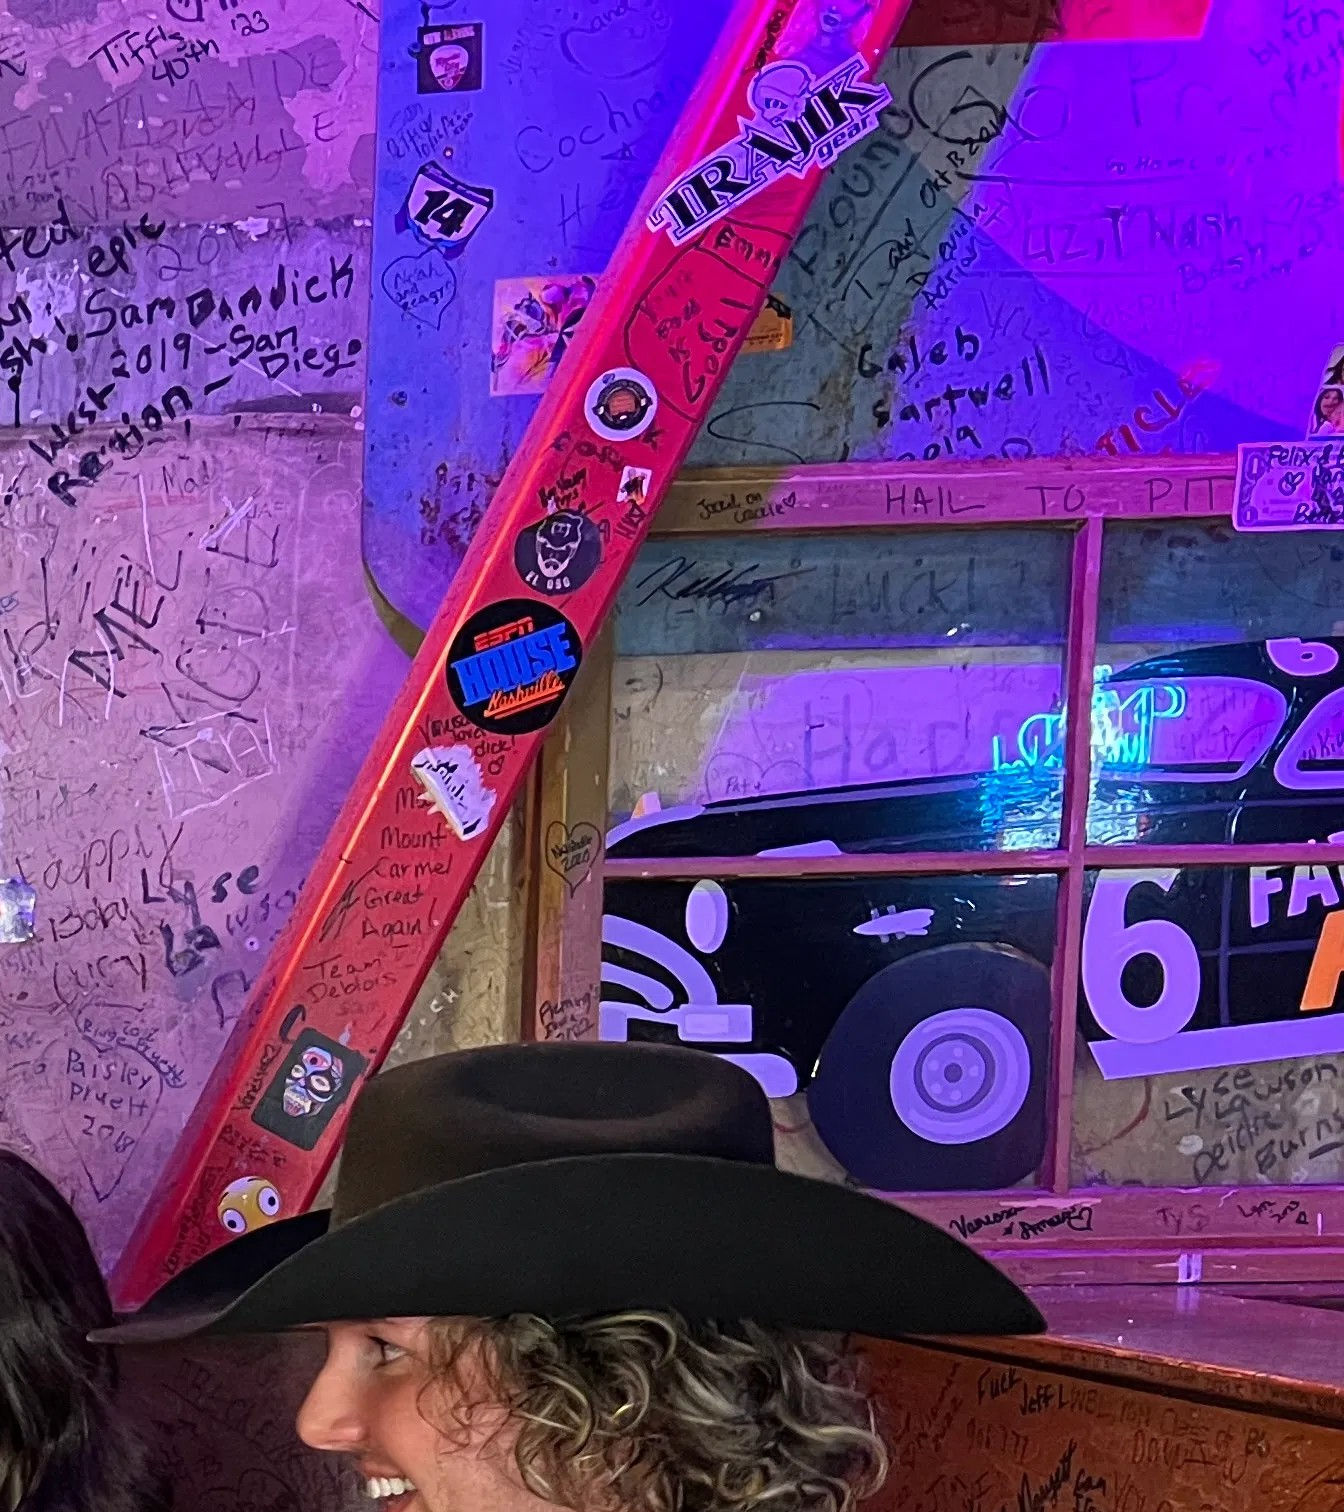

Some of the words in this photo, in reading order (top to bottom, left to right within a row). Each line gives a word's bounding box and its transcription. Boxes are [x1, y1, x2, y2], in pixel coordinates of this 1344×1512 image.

[816, 114, 876, 162] gear
[413, 188, 475, 238] 14
[110, 332, 193, 379] 2019
[264, 338, 364, 381] Diego
[885, 484, 985, 517] HAIL
[1024, 484, 1086, 512] TO
[473, 615, 537, 652] ESPN
[450, 622, 580, 706] HOUSE
[483, 669, 566, 720] Nashville
[380, 824, 448, 851] Mount
[373, 853, 454, 878] Carmel
[364, 885, 425, 911] Great
[1081, 866, 1202, 1045] 6
